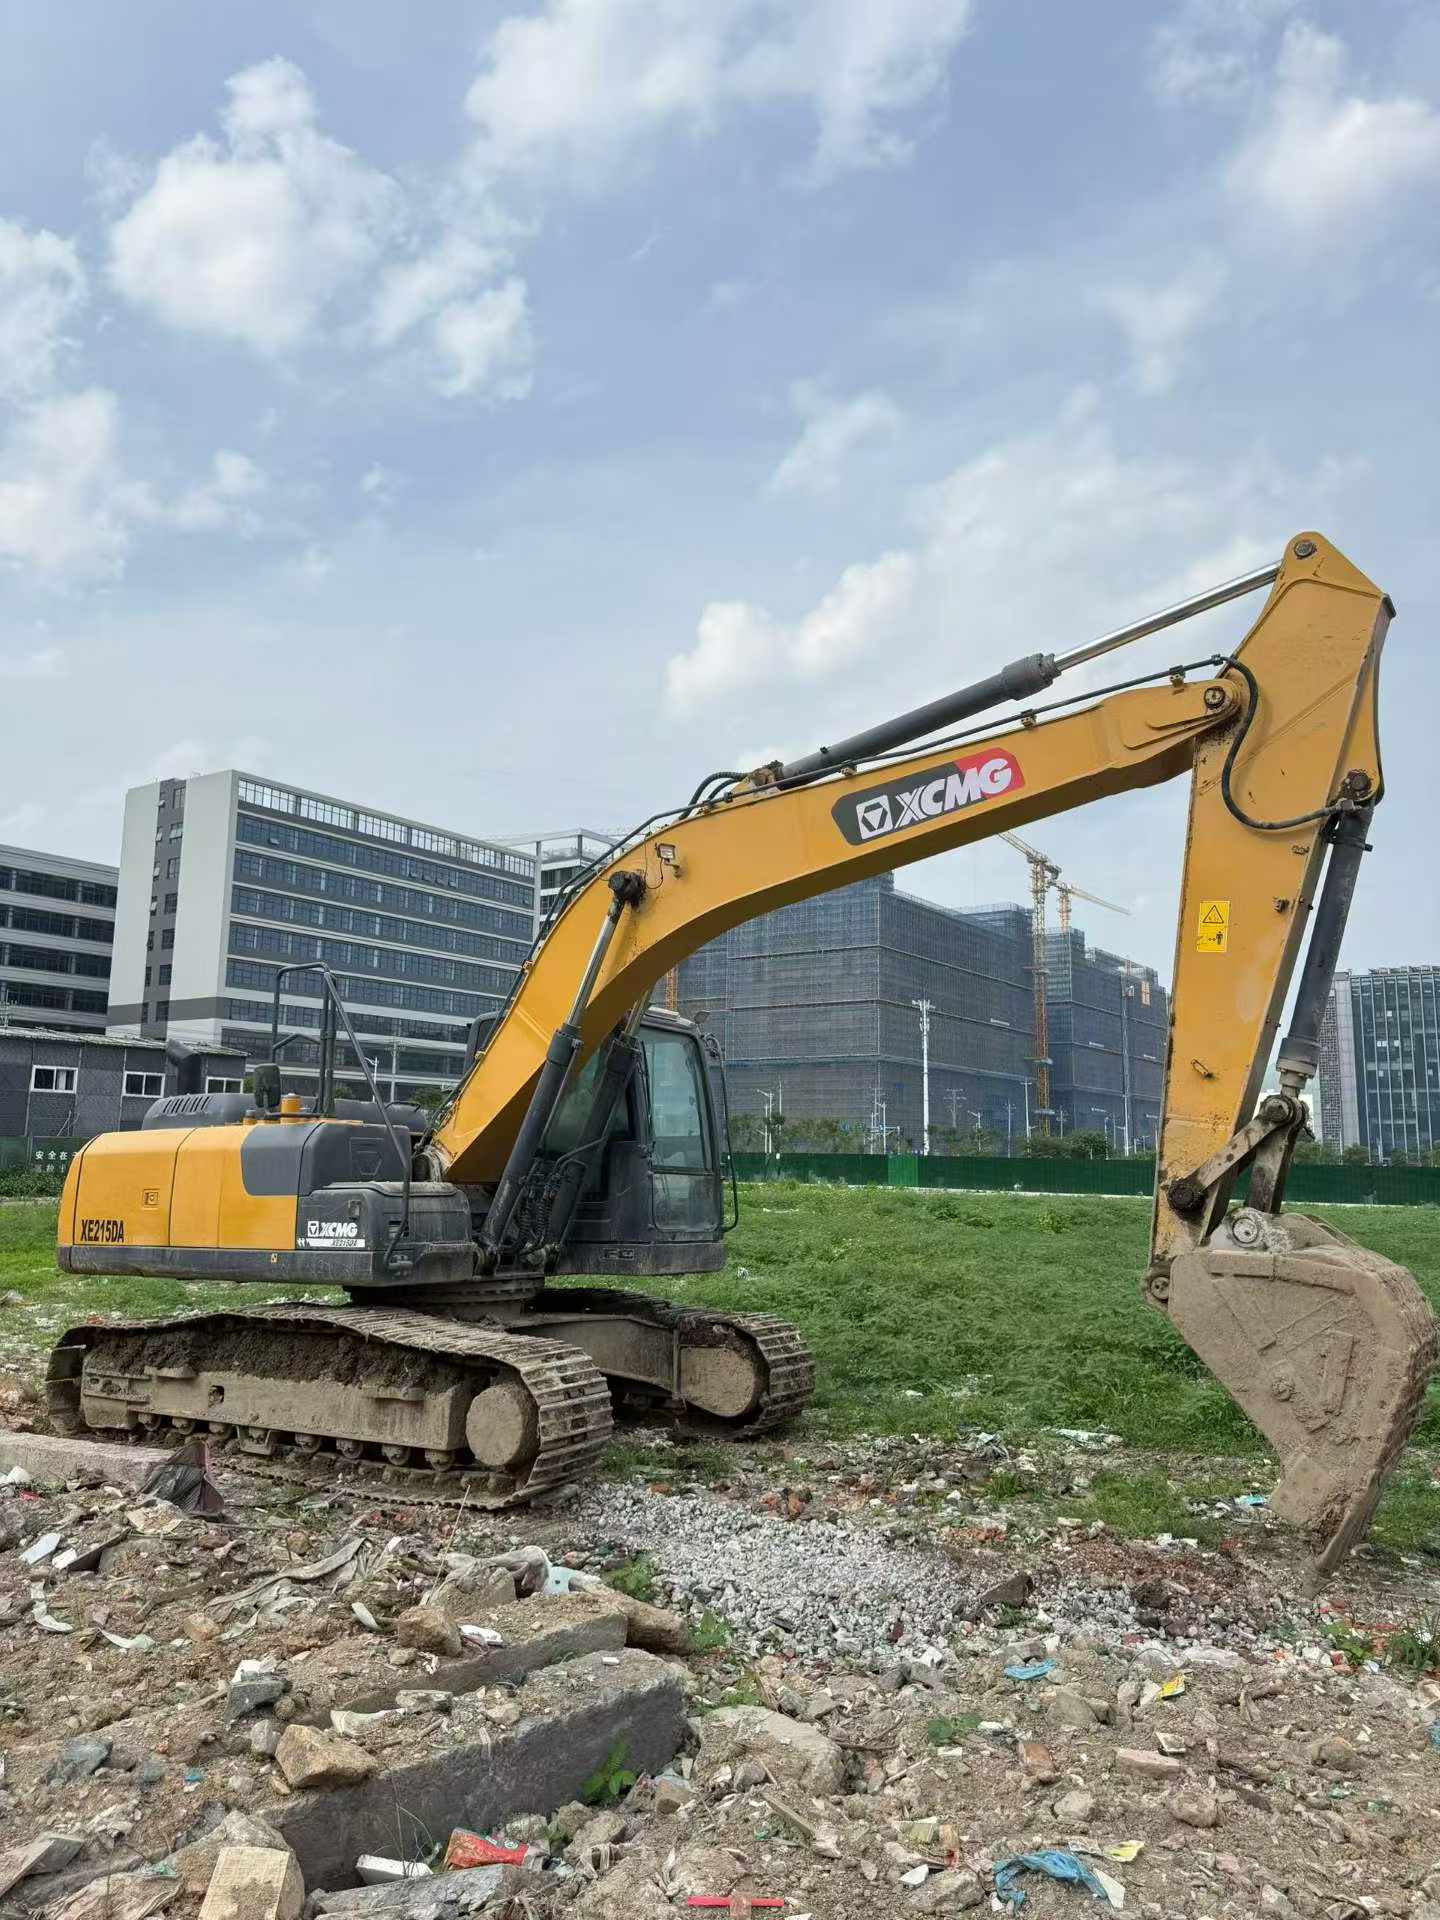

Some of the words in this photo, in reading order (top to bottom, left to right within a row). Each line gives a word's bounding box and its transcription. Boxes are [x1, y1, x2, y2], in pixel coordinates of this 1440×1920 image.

[894, 758, 1012, 829] XCMG
[80, 1219, 125, 1243] XE215DA
[319, 1221, 358, 1238] XCMG
